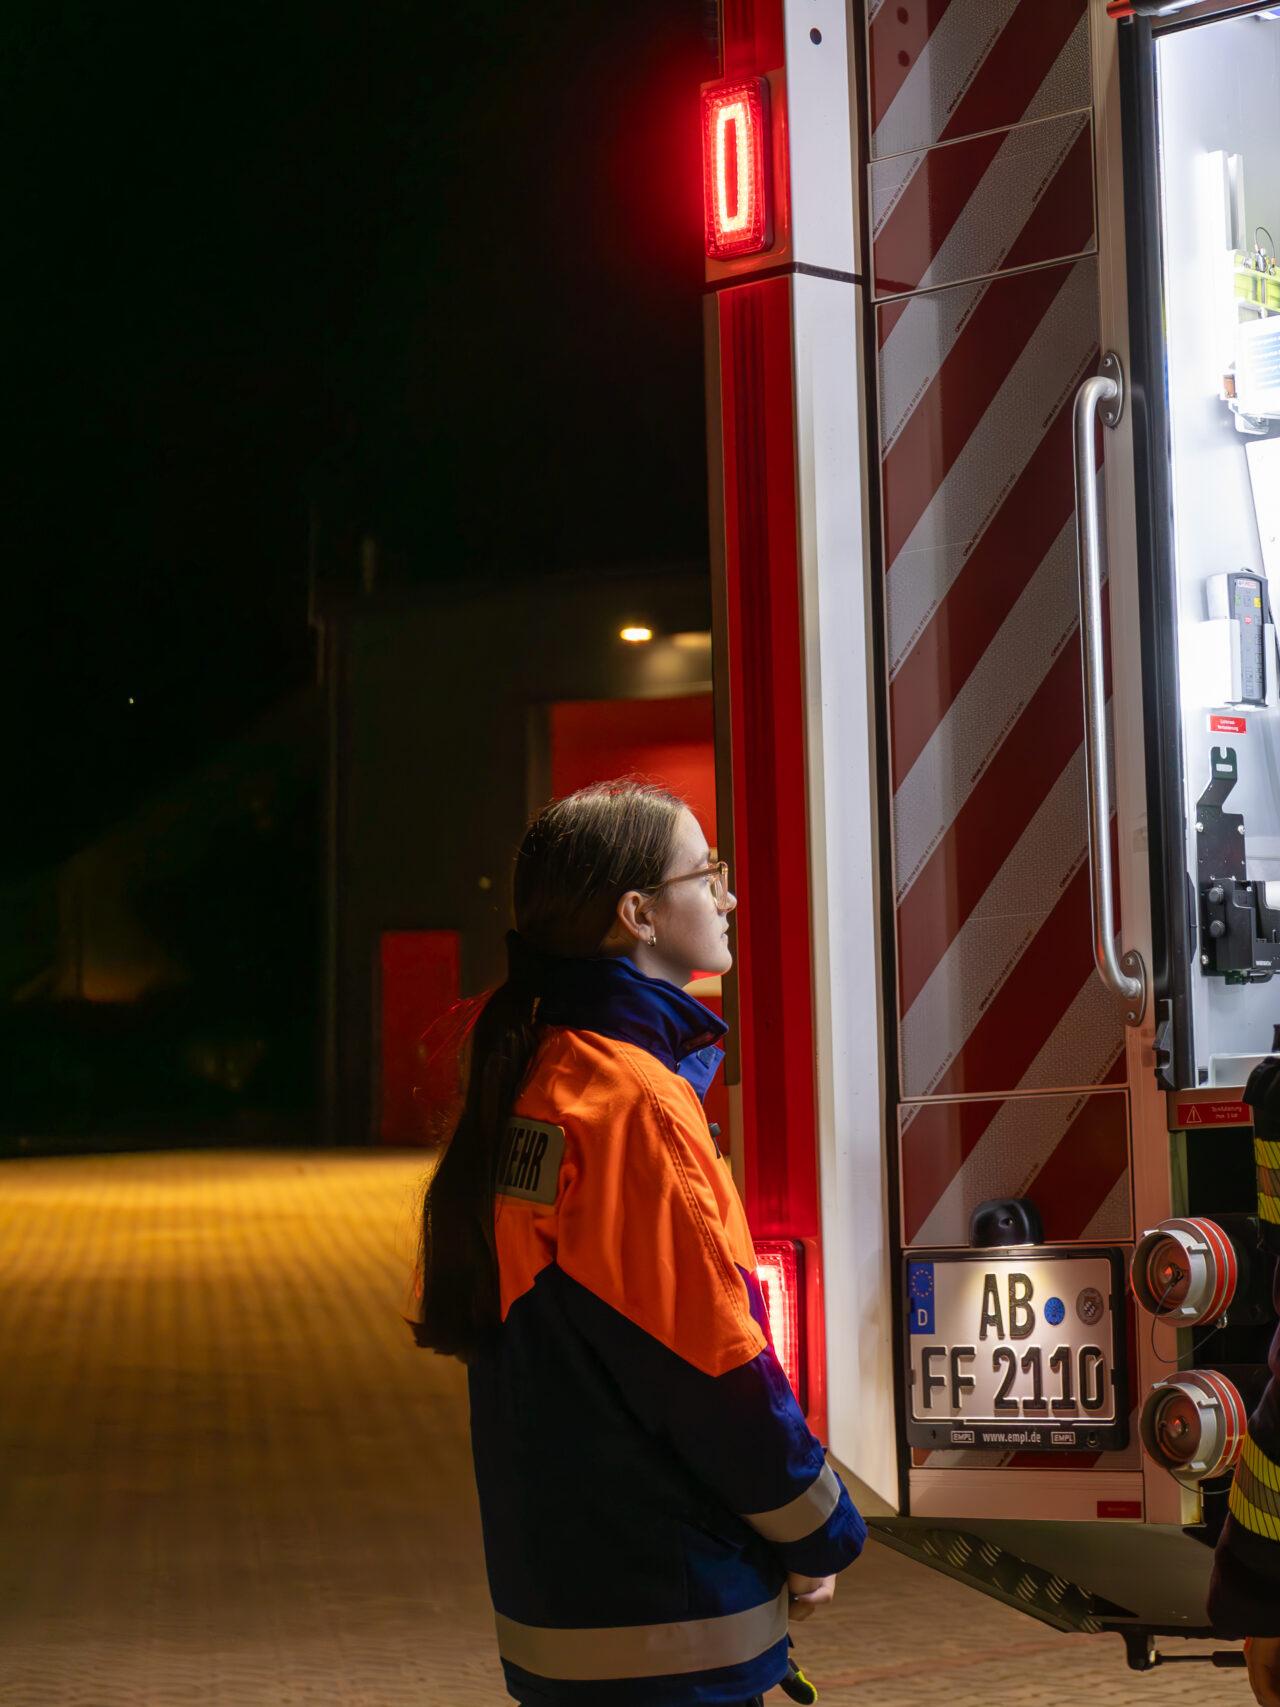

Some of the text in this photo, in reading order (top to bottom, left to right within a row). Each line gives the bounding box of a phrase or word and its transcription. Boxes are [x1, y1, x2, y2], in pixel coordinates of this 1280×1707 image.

[979, 1273, 1036, 1340] AB
[917, 1309, 928, 1326] D
[921, 1346, 1104, 1409] FF 2110
[954, 1433, 973, 1441] EMPL
[983, 1432, 1041, 1445] www.empl.de
[1054, 1434, 1073, 1442] EMPL
